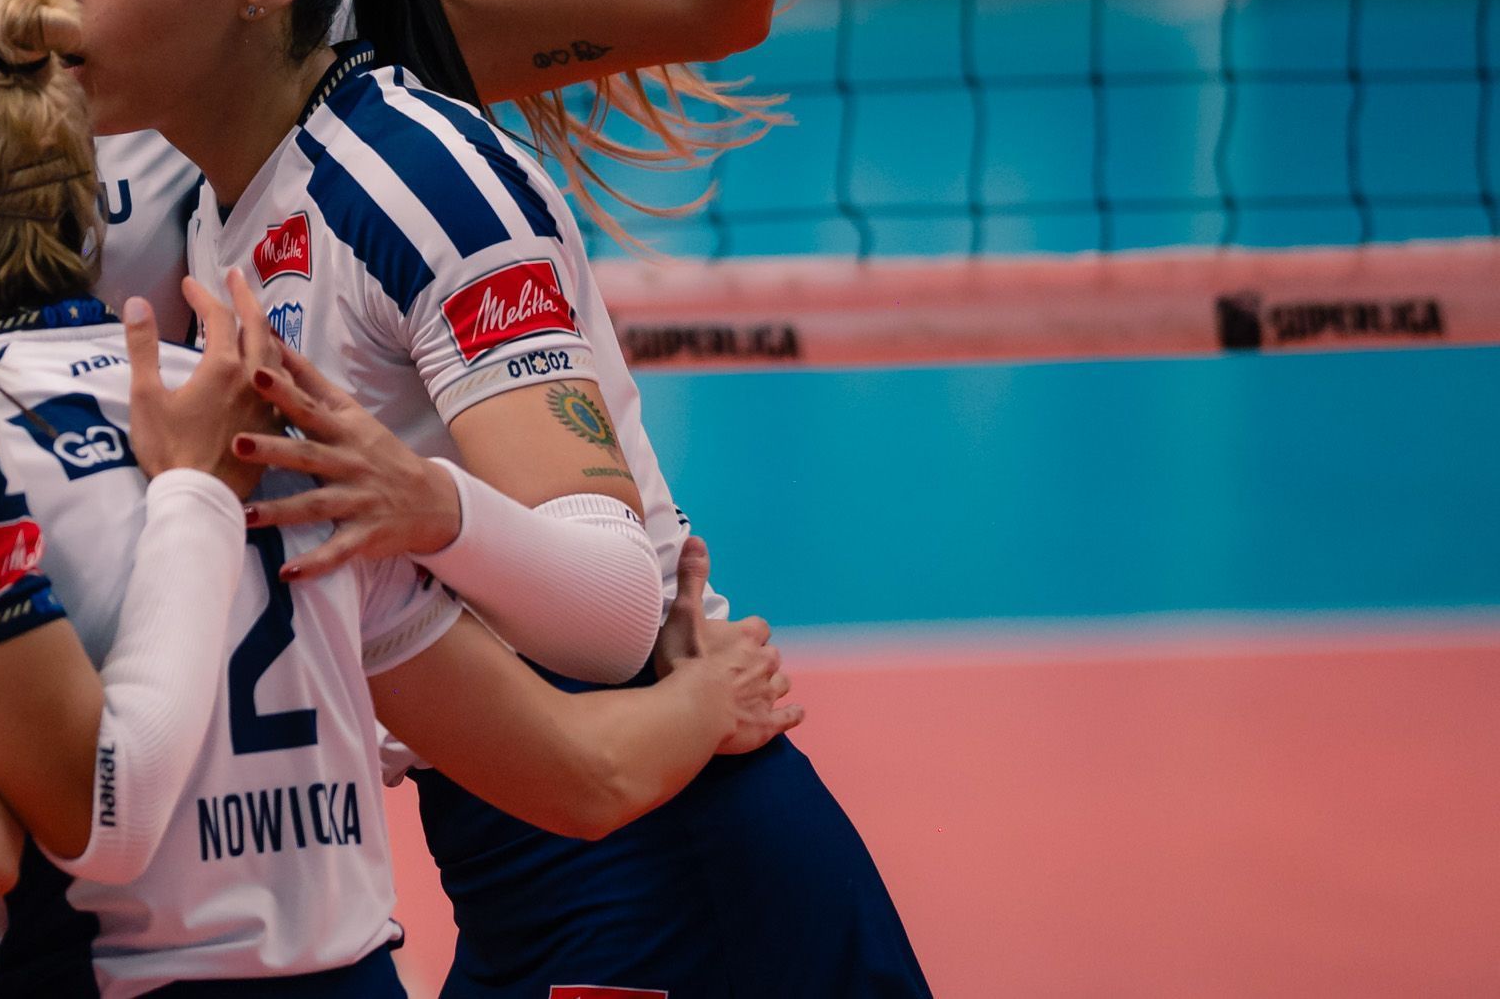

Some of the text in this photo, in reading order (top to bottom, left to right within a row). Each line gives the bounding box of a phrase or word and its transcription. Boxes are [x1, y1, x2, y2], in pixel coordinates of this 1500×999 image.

[260, 231, 303, 264] Melitta
[471, 279, 558, 343] Melitta
[1268, 300, 1443, 343] SUPERLIGA
[228, 523, 318, 755] 2
[197, 781, 362, 861] NOWICKA
